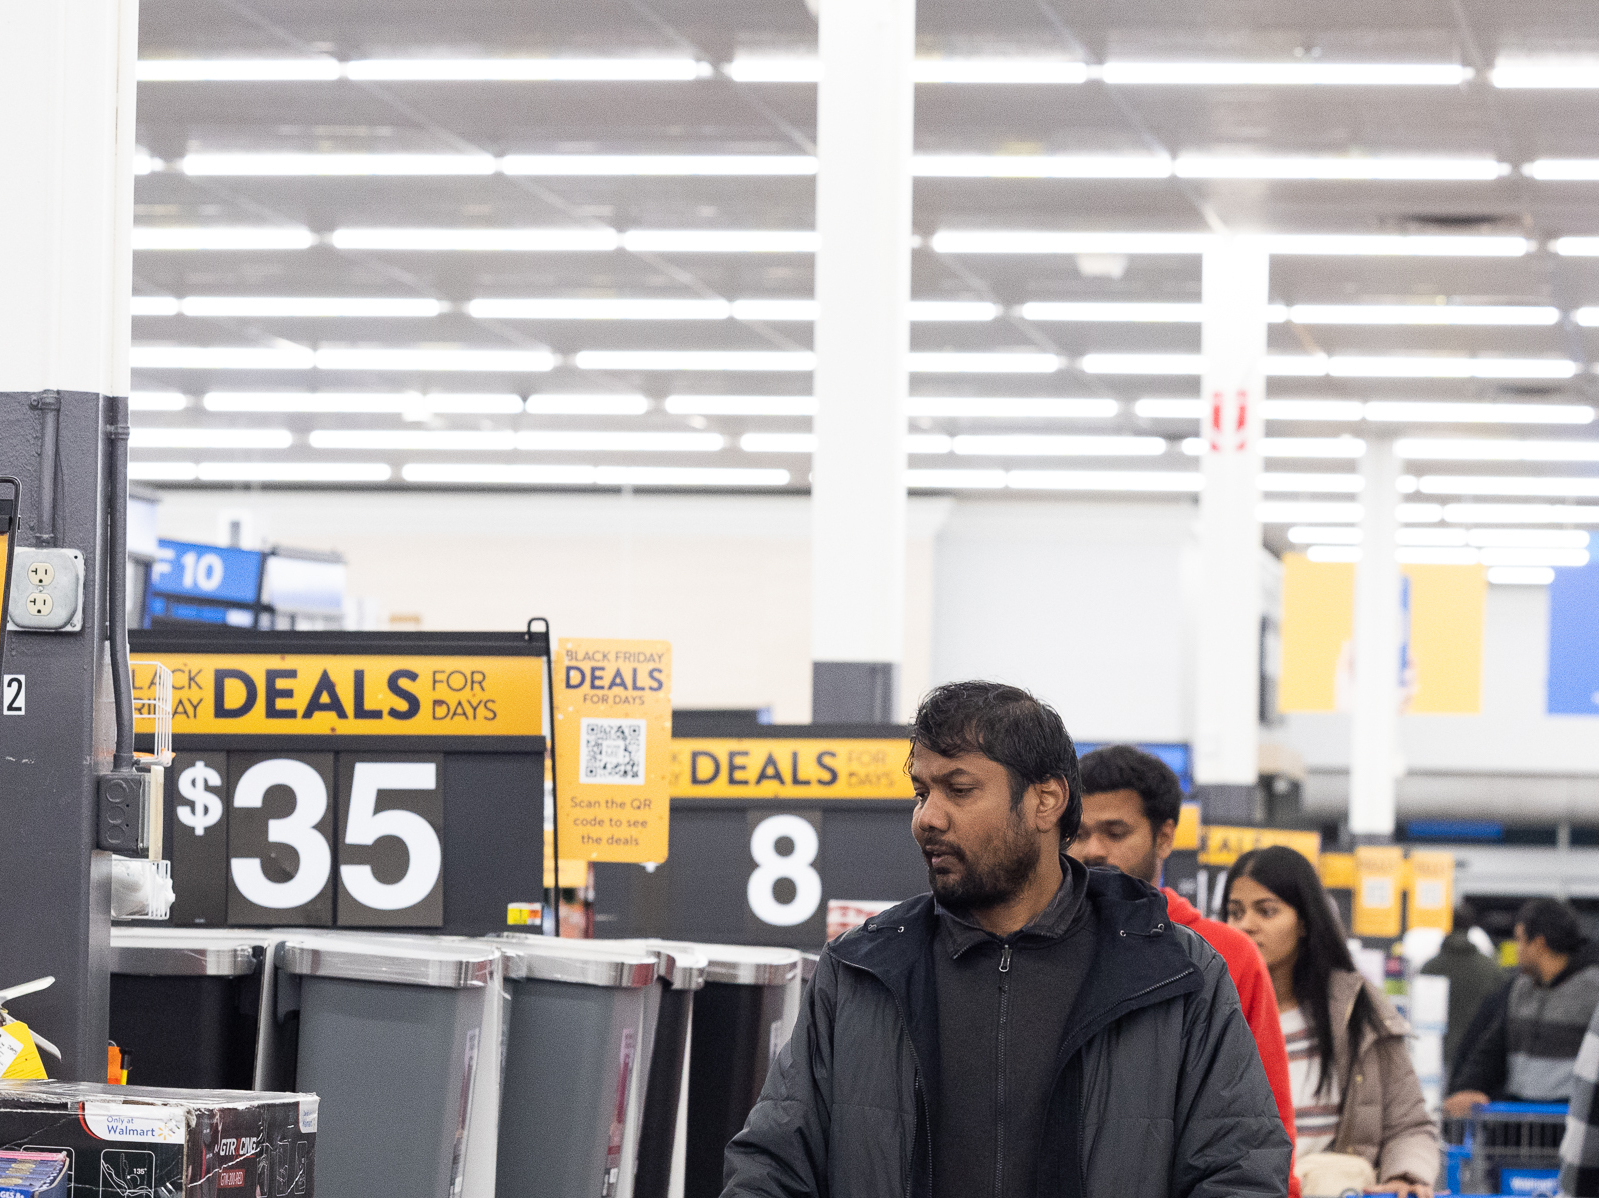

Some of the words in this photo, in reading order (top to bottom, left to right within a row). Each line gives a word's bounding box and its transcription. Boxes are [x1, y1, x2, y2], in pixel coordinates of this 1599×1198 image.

[182, 551, 224, 592] 10
[566, 650, 610, 662] BLACK
[615, 651, 665, 664] FRIDAY
[131, 668, 203, 690] LACK
[432, 669, 486, 692] FOR
[565, 665, 664, 692] DEALS
[7, 677, 22, 711] 2
[214, 668, 421, 720] DEALS
[583, 694, 609, 705] FOR
[613, 694, 645, 706] DAYS
[432, 699, 497, 722] DAYS
[690, 751, 839, 786] DEALS
[846, 750, 887, 766] FOR
[570, 797, 601, 809] Scan
[605, 798, 626, 810] the
[631, 799, 652, 810] QR
[573, 816, 605, 828] code
[610, 817, 623, 828] to
[627, 819, 648, 828] see
[177, 757, 442, 911] $35
[581, 834, 602, 845] the
[606, 835, 639, 846] deals
[107, 1116, 124, 1125] Only
[107, 1125, 155, 1137] Walmart
